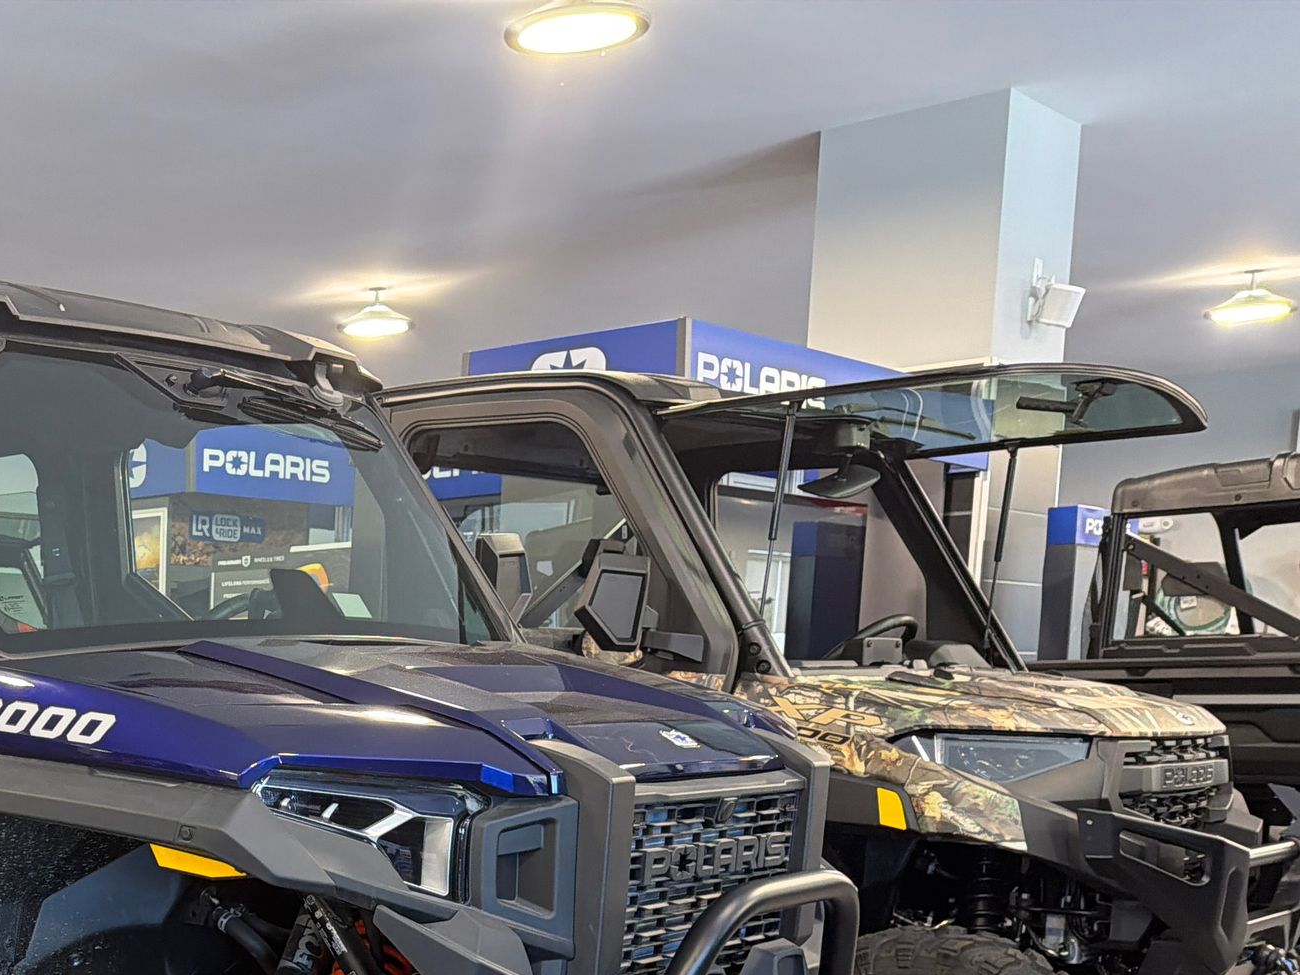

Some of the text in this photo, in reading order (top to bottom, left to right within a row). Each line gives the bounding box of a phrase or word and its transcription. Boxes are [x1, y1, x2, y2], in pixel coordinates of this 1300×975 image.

[202, 448, 330, 483] POLARIS
[215, 516, 238, 527] LOCK
[243, 525, 262, 535] MAX
[766, 695, 882, 726] XP
[643, 831, 787, 886] POLARIS
